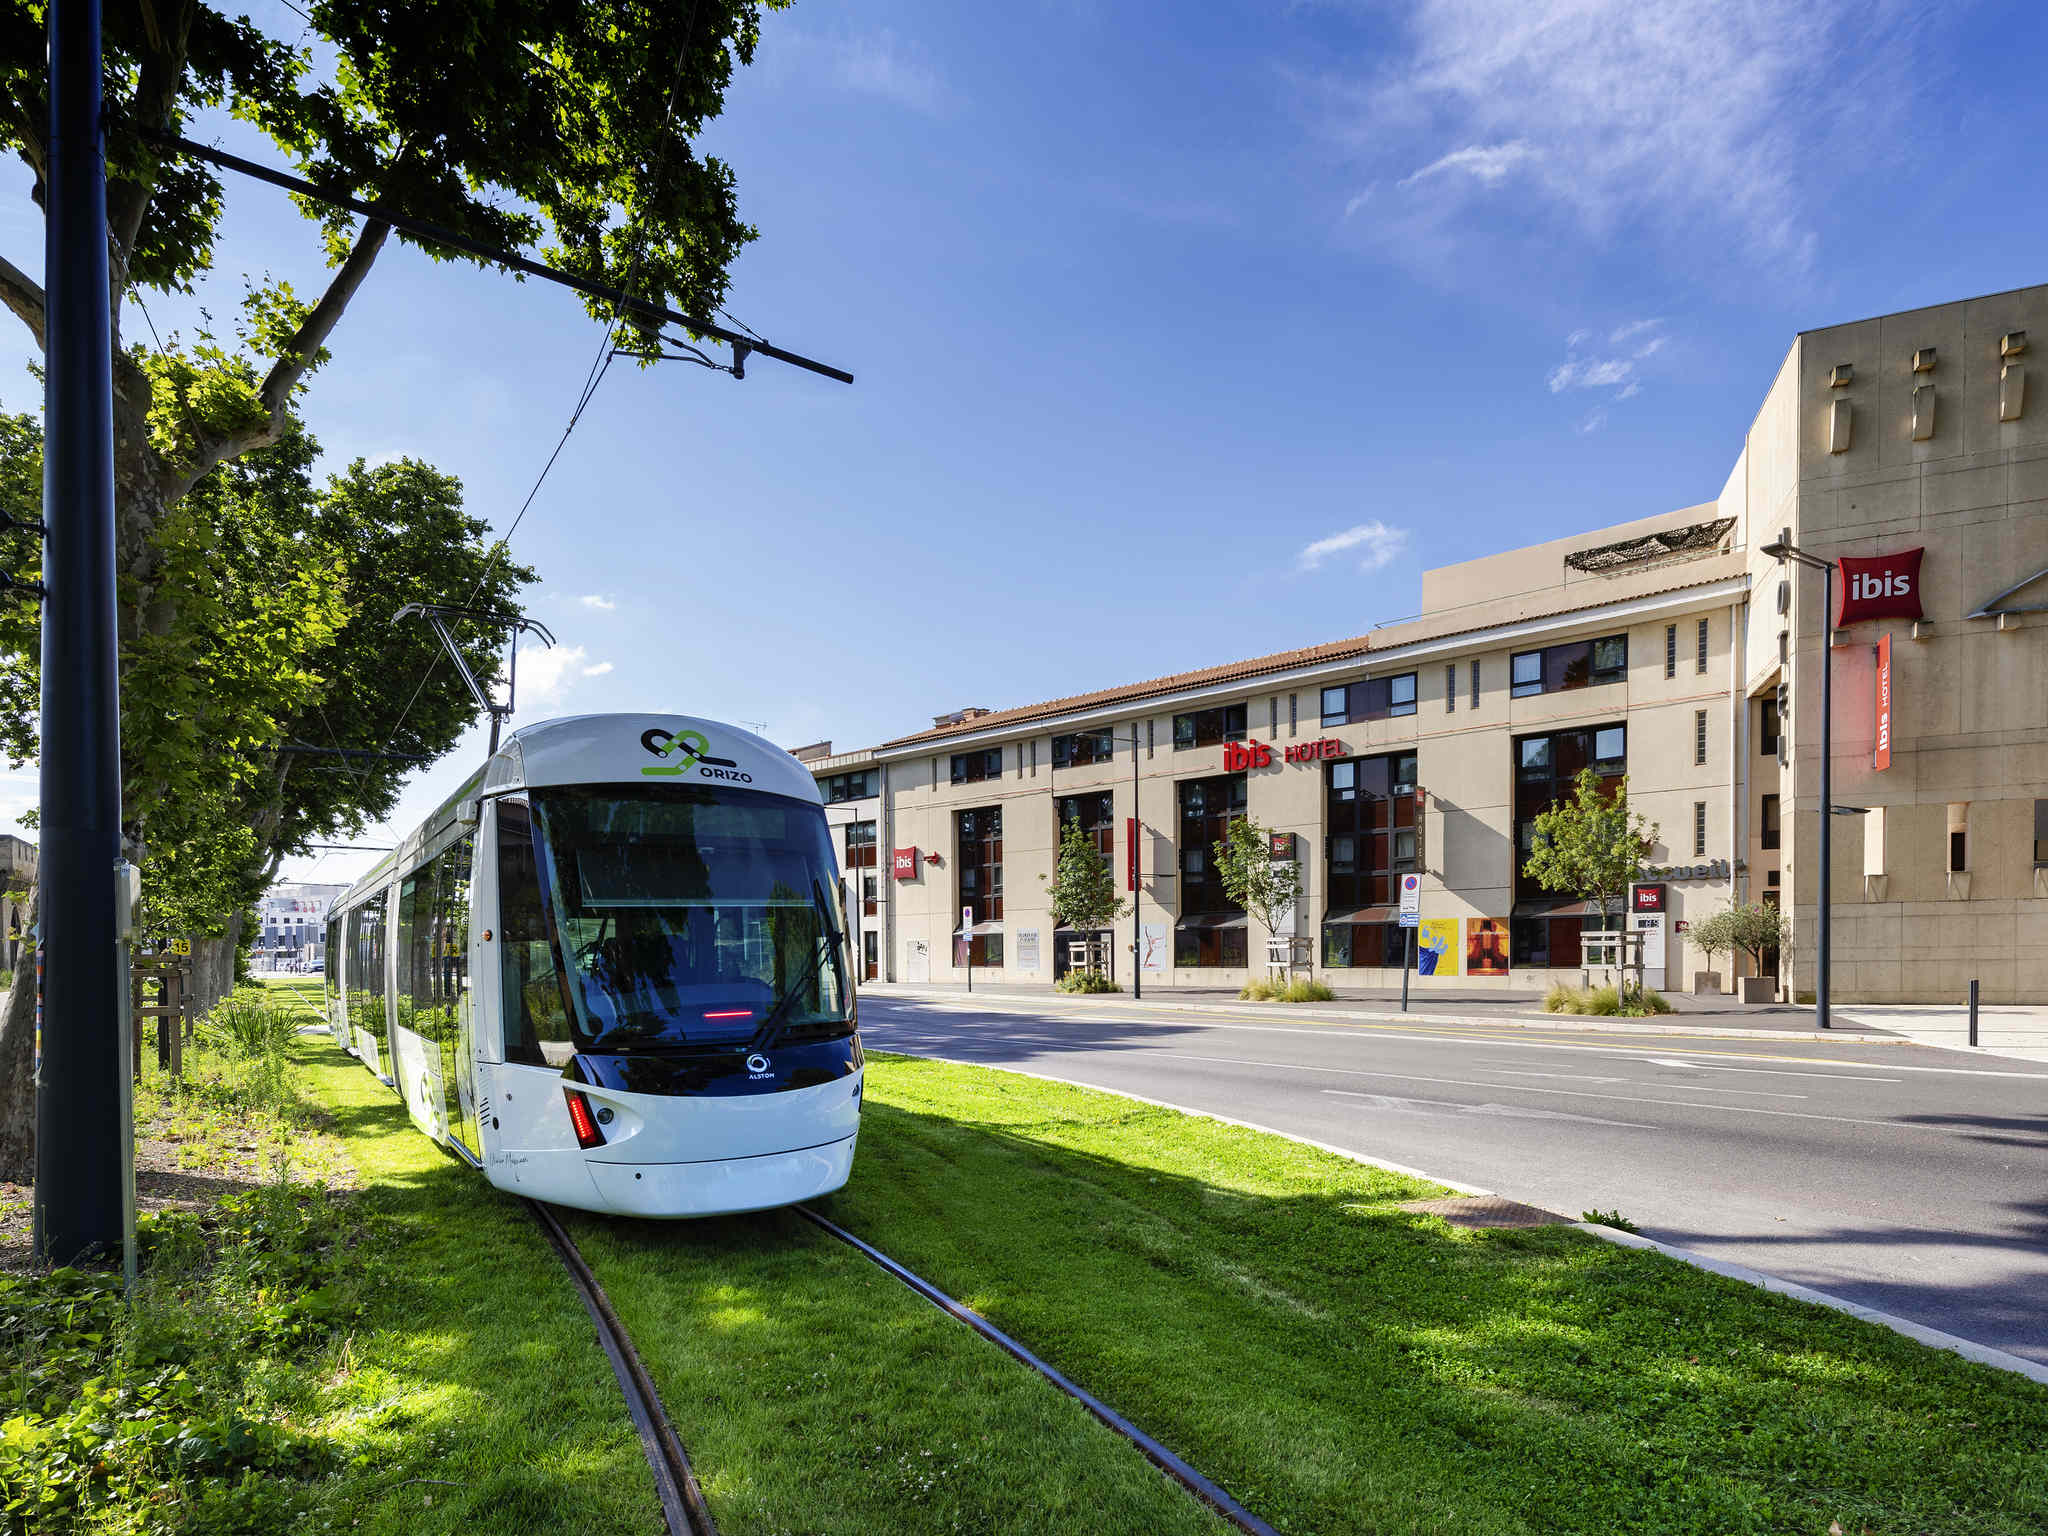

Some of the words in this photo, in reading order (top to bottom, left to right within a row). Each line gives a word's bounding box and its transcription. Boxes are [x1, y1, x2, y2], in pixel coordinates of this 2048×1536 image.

[1852, 571, 1911, 601] ibis
[1879, 713, 1888, 751] ibis
[1224, 739, 1271, 772] ibis
[1285, 738, 1347, 763] HOTEL
[700, 767, 752, 783] ORIZO
[895, 856, 912, 869] ibis
[1640, 893, 1656, 903] ibis
[175, 943, 188, 952] 15
